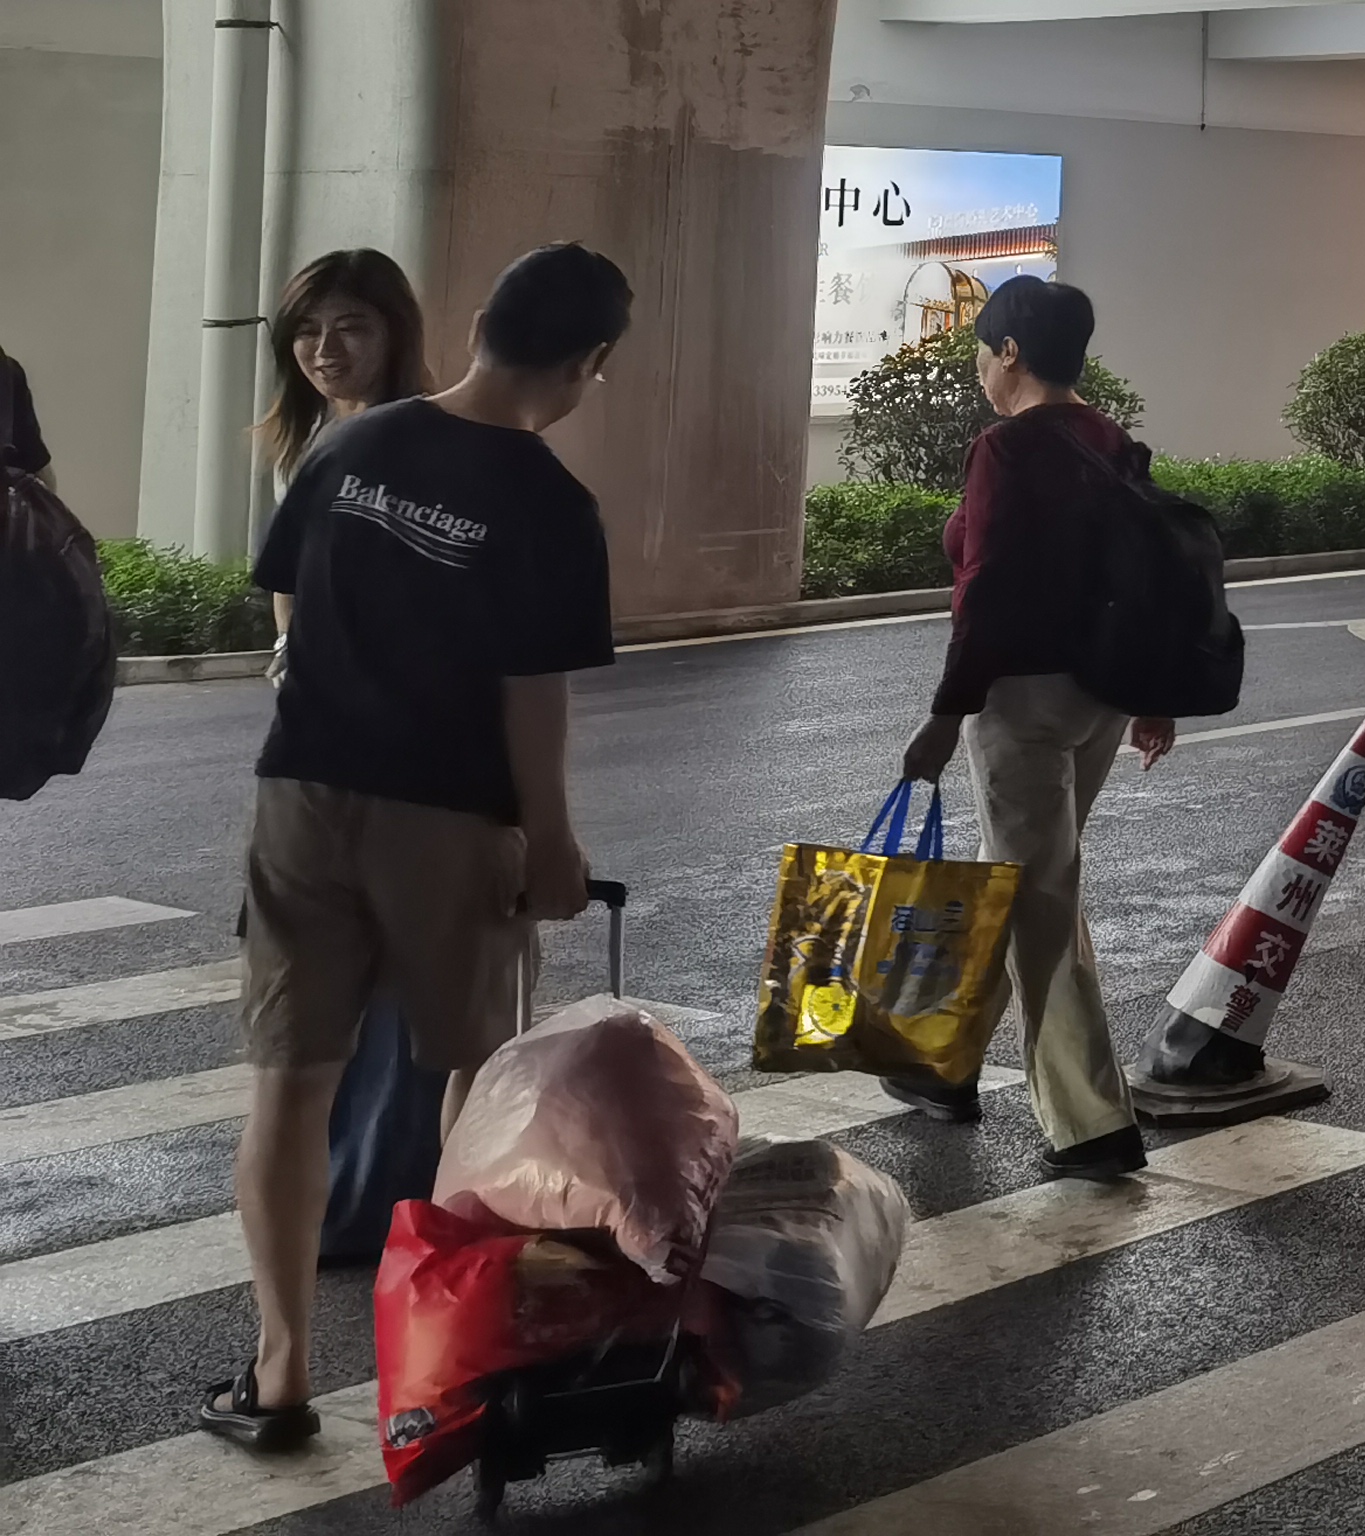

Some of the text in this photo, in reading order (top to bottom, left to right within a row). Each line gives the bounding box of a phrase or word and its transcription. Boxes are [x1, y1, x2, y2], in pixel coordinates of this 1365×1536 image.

[824, 178, 911, 227] 中心
[337, 474, 488, 541] Balenciaga
[1220, 819, 1350, 1034] 莱州交警
